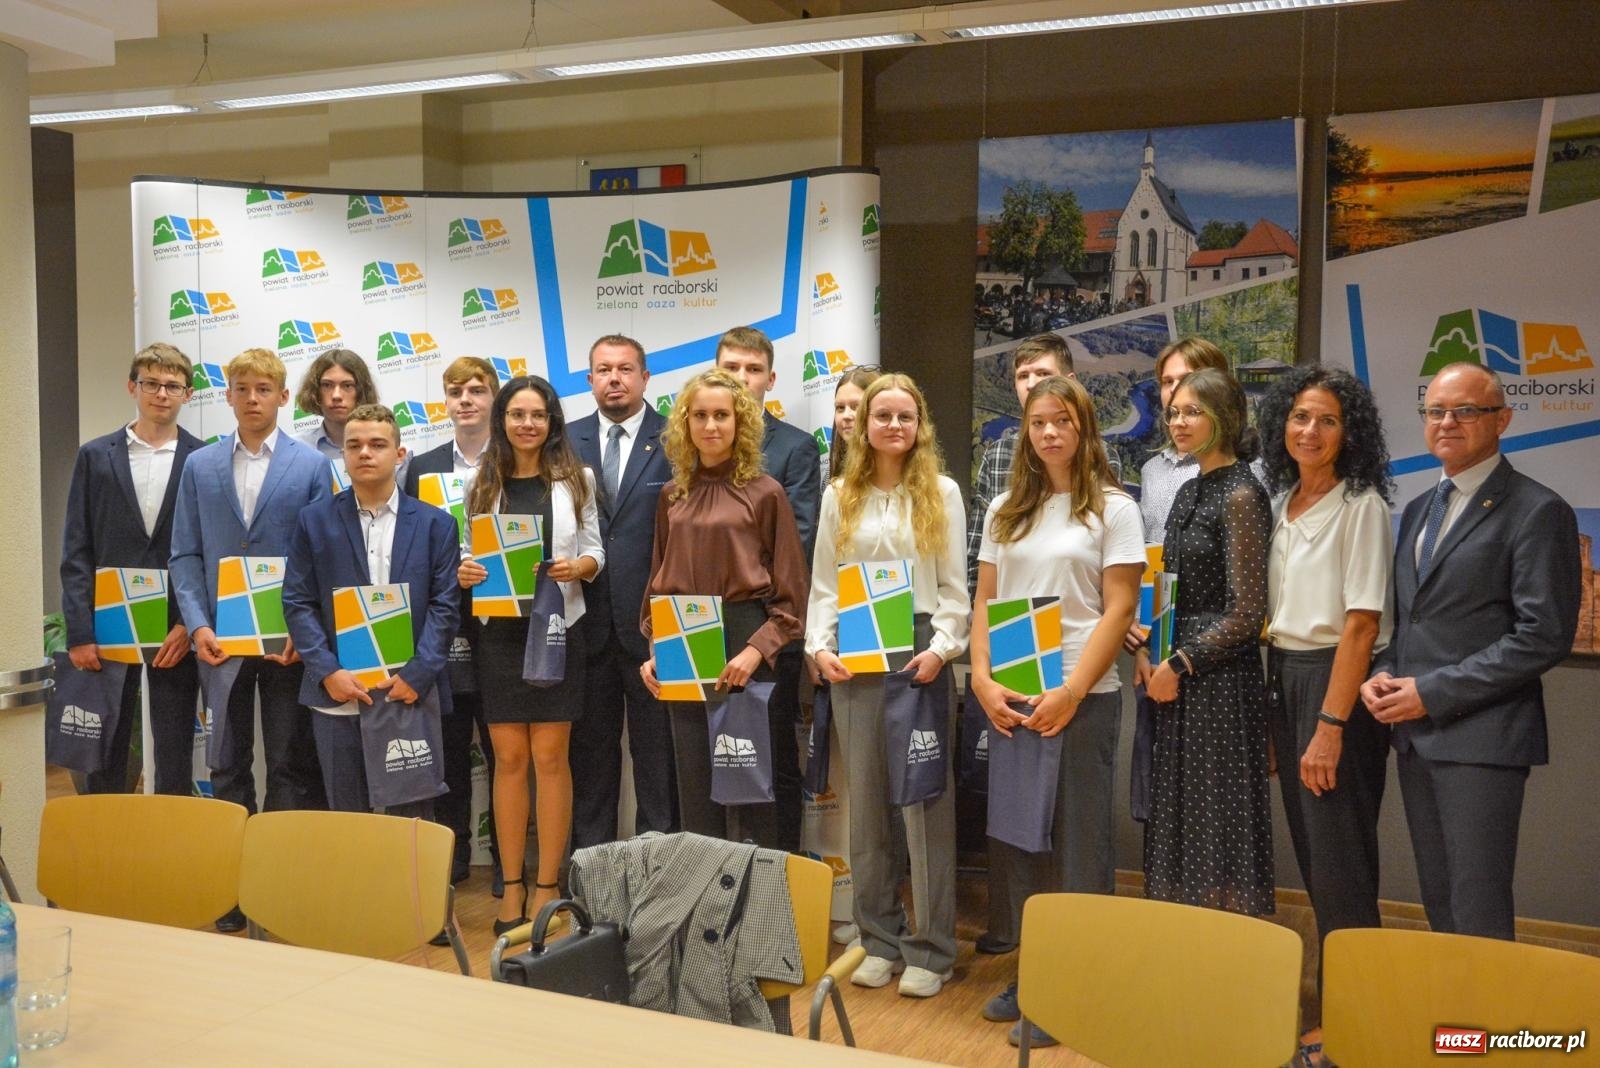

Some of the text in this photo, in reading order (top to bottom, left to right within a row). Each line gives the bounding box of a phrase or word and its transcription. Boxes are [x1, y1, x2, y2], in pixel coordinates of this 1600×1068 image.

[246, 205, 272, 214] powiat
[277, 198, 313, 210] raciborski
[348, 219, 372, 230] powiat
[377, 212, 412, 224] raciborski
[153, 245, 180, 256] powiat
[185, 240, 223, 250] raciborski
[448, 246, 472, 256] powiat
[476, 238, 510, 250] raciborski
[262, 276, 288, 288] powiat
[293, 271, 328, 282] raciborski
[362, 289, 388, 300] powiat
[392, 282, 426, 294] raciborski
[597, 278, 718, 300] powiat raciborski
[597, 298, 717, 310] zielona oaza kultur
[170, 319, 197, 330] powiat
[202, 313, 239, 325] raciborski
[462, 315, 486, 327] powiat
[279, 341, 344, 358] powiat raciborski
[377, 360, 402, 371] powiat
[406, 352, 441, 364] raciborski
[190, 390, 214, 401] owiat
[1542, 400, 1594, 411] kultur
[294, 418, 319, 430] powiat
